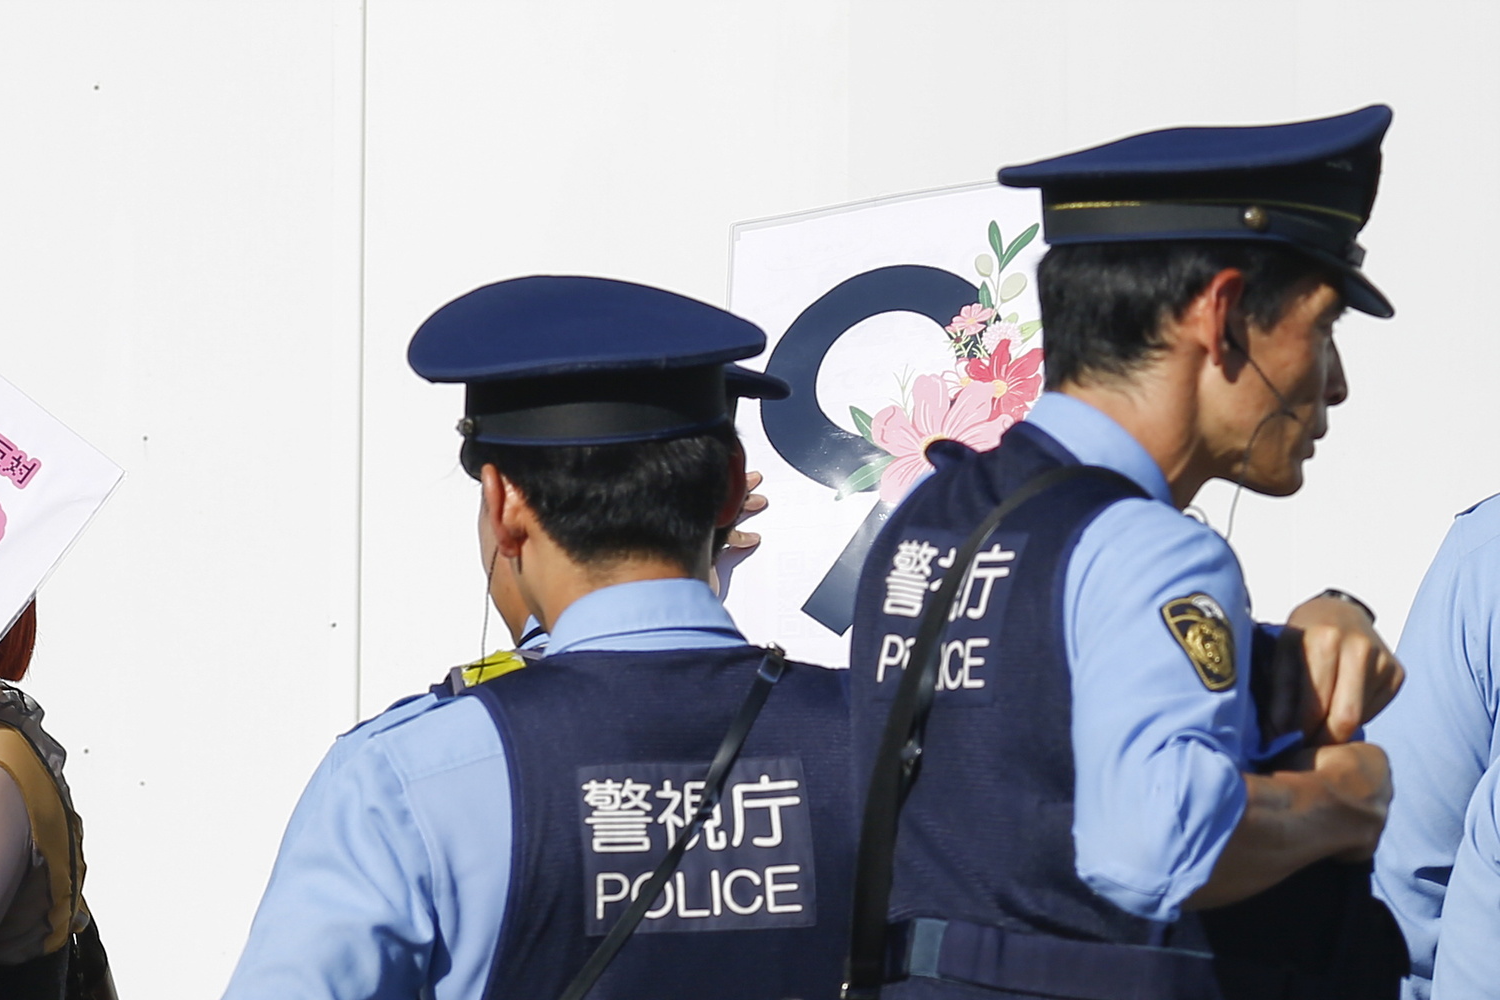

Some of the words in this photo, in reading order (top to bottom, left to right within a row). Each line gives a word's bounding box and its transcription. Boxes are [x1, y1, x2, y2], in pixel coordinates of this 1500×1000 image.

[883, 540, 1015, 621] 警庁
[582, 775, 800, 852] 警視庁
[597, 865, 802, 919] POLICE
